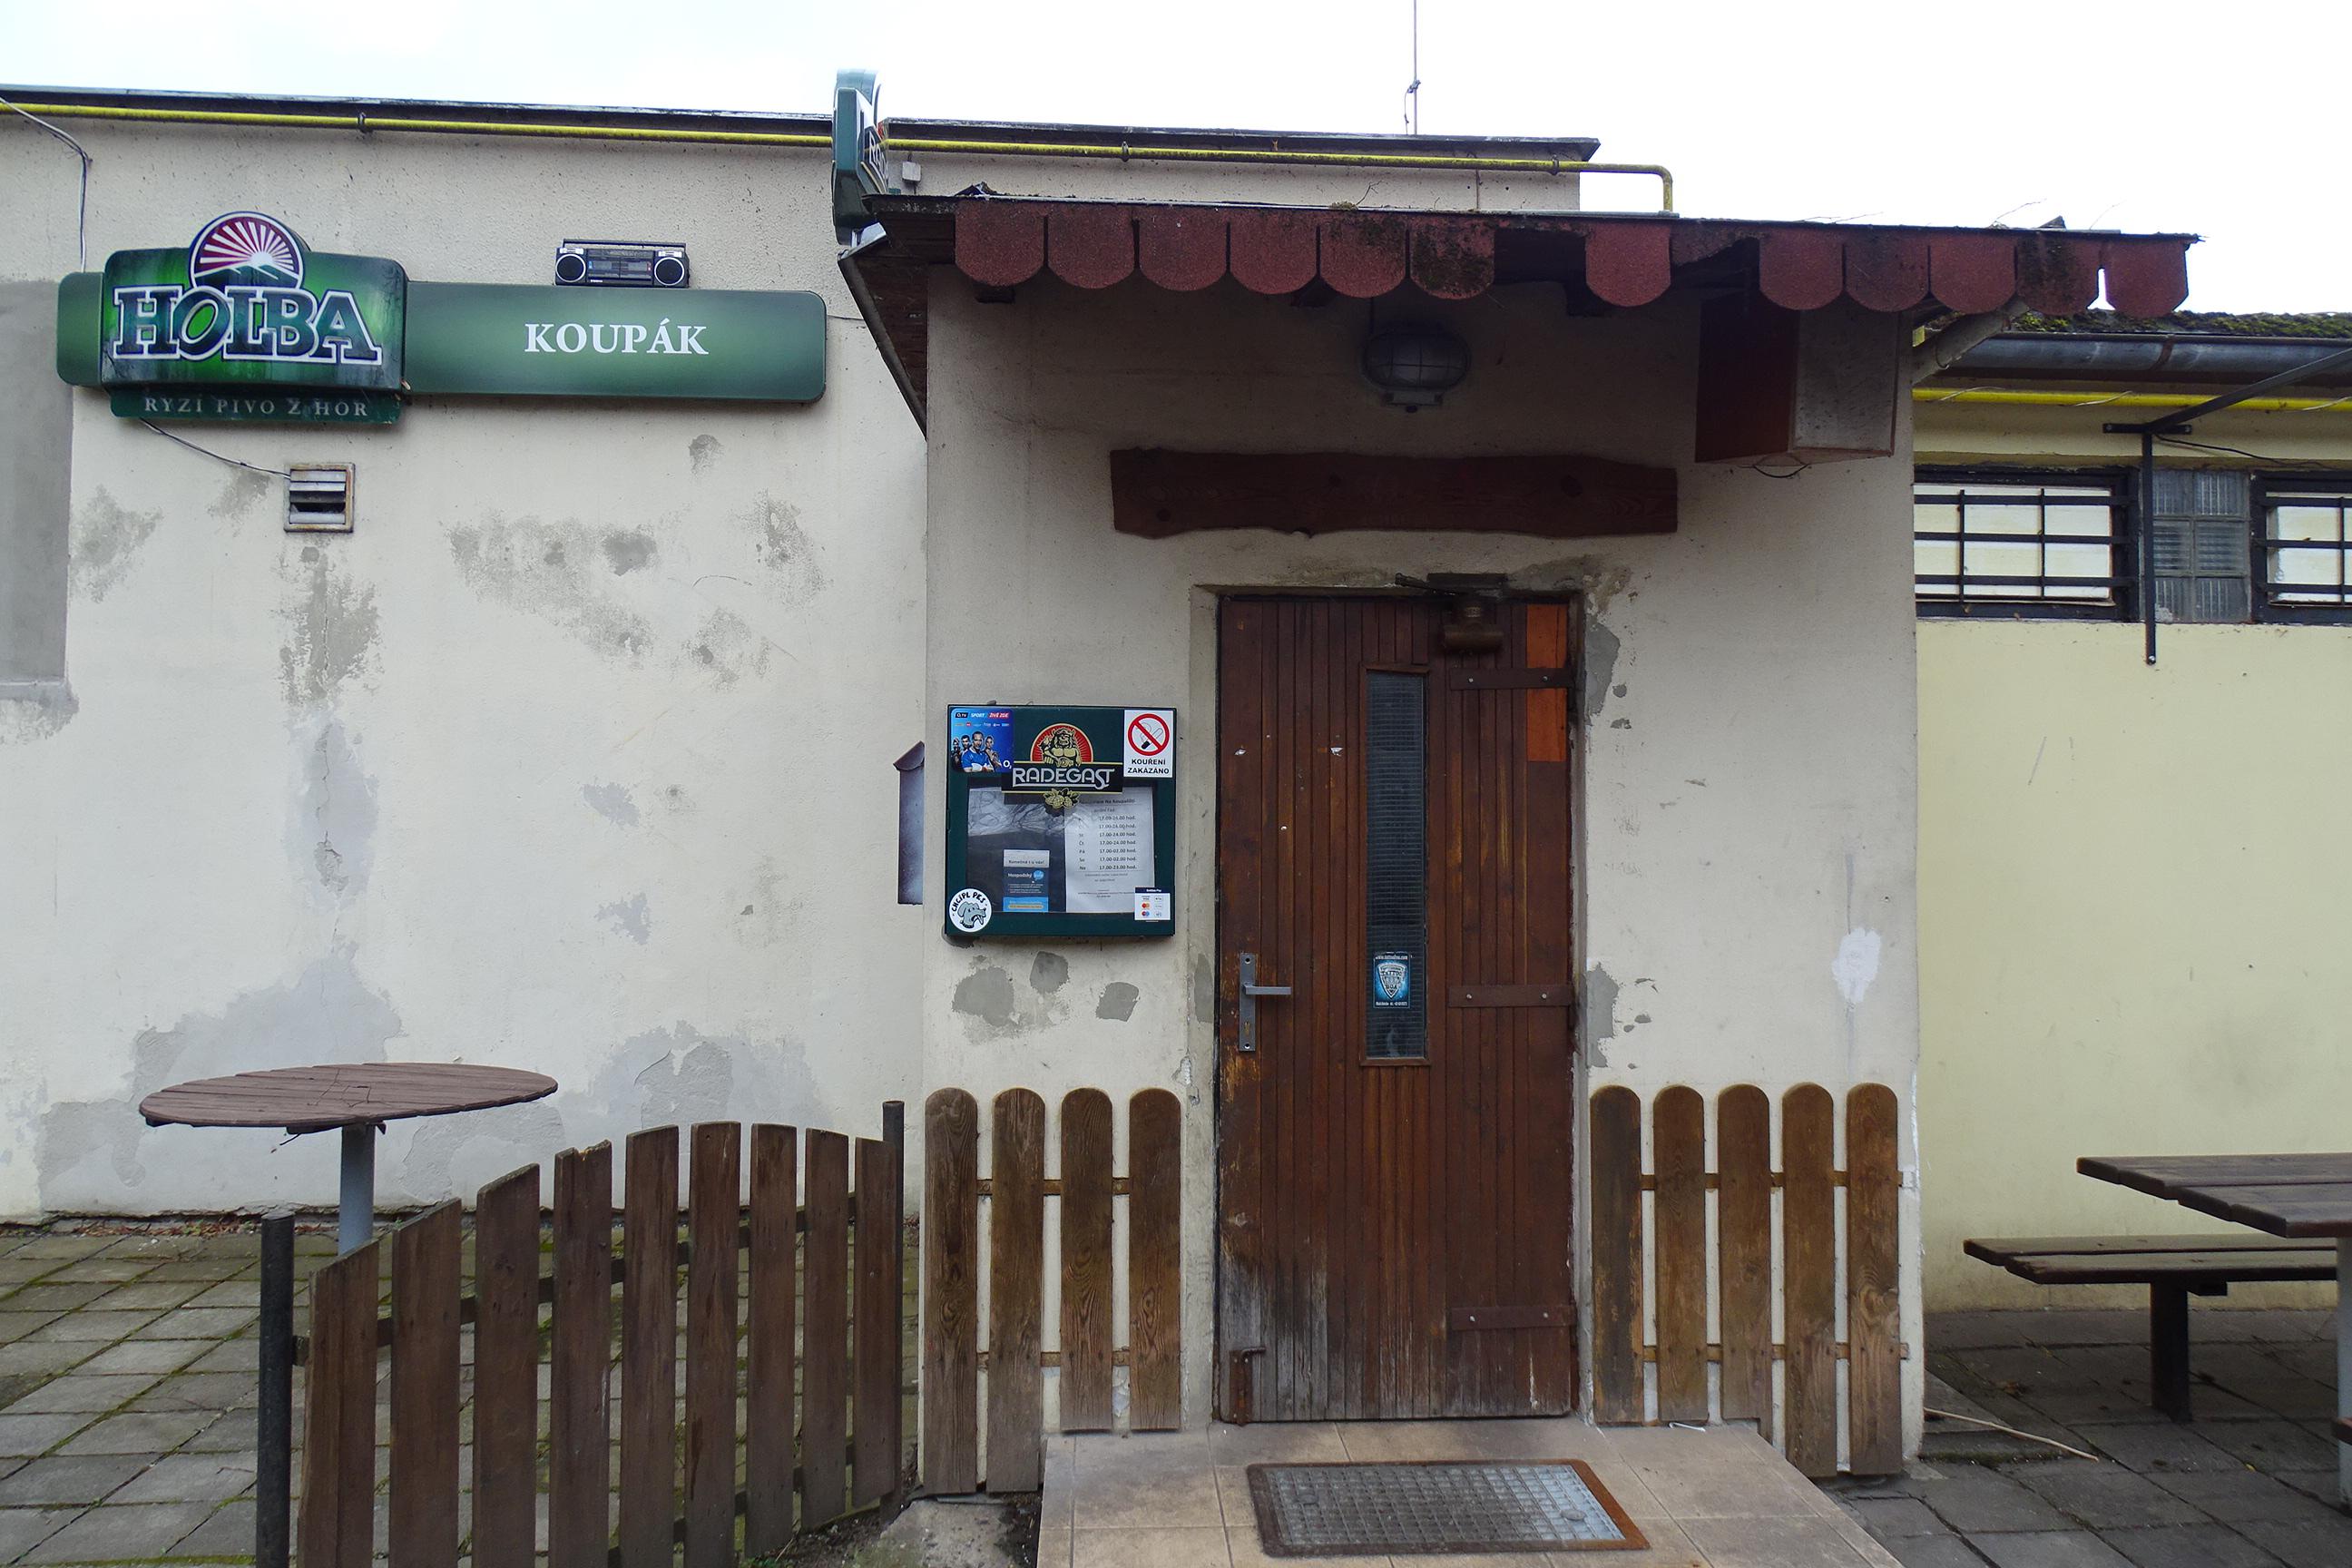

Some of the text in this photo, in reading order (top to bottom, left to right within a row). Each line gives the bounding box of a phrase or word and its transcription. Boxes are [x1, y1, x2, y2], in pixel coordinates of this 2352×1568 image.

[113, 284, 382, 365] HOLBA
[524, 318, 710, 355] KOUPÁK
[216, 397, 275, 414] PIVO
[314, 399, 368, 416] HOR
[1012, 767, 1115, 789] RADEGAST
[972, 892, 986, 903] PES
